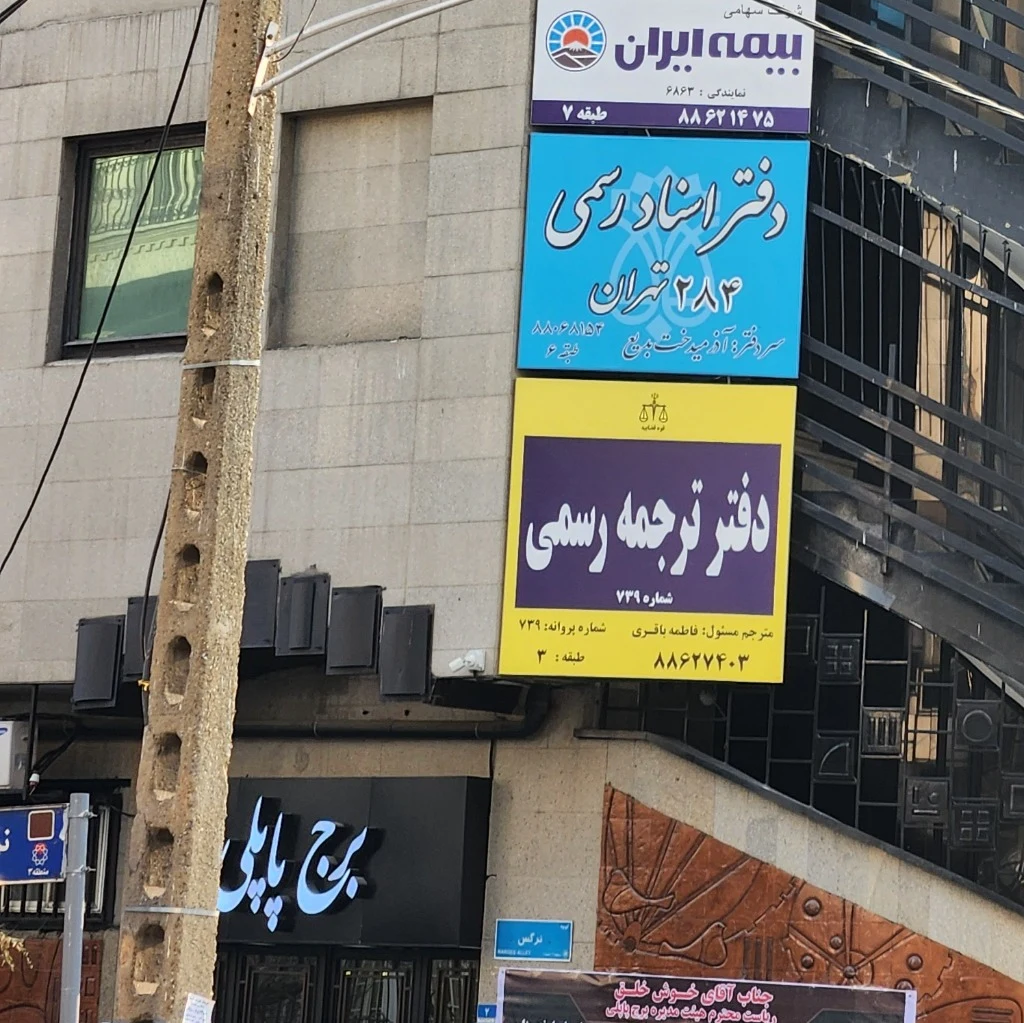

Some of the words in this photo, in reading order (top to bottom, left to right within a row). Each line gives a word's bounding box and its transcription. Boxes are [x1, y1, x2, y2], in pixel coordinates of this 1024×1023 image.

[723, 4, 763, 19] سهامی
[614, 27, 704, 71] ایران
[709, 31, 803, 76] بیمه
[666, 85, 694, 96] ۶۸۶۳
[707, 88, 746, 99] نمایندگی
[562, 104, 574, 122] ۷
[577, 105, 608, 125] طبقه
[544, 165, 627, 251] رسمی
[633, 175, 717, 232] اسناد
[695, 155, 788, 256] دفتر
[588, 260, 670, 315] تهران
[673, 274, 743, 314] ۲۸۴
[557, 343, 580, 365] طبقه
[616, 479, 704, 576] ترجمه
[705, 471, 770, 576] دفتر
[525, 502, 608, 573] رسمی
[616, 590, 640, 605] ۷۳۹
[642, 591, 673, 607] شماره
[519, 619, 540, 631] ۷۳۹
[578, 622, 606, 636] شماره
[632, 623, 666, 638] باقری
[669, 624, 698, 636] فاطمه
[742, 628, 774, 641] مترجم
[537, 649, 547, 664] ۳
[561, 652, 585, 665] طبقه
[654, 651, 749, 672] ۸۸۶۲۷۴۰۳
[297, 820, 368, 915] برج
[518, 932, 543, 946] نرگس
[614, 979, 650, 1001] خلق
[652, 982, 699, 1003] خوش
[701, 983, 736, 1006] آقای
[737, 986, 773, 1008] جناب
[650, 1004, 679, 1021] مدیره
